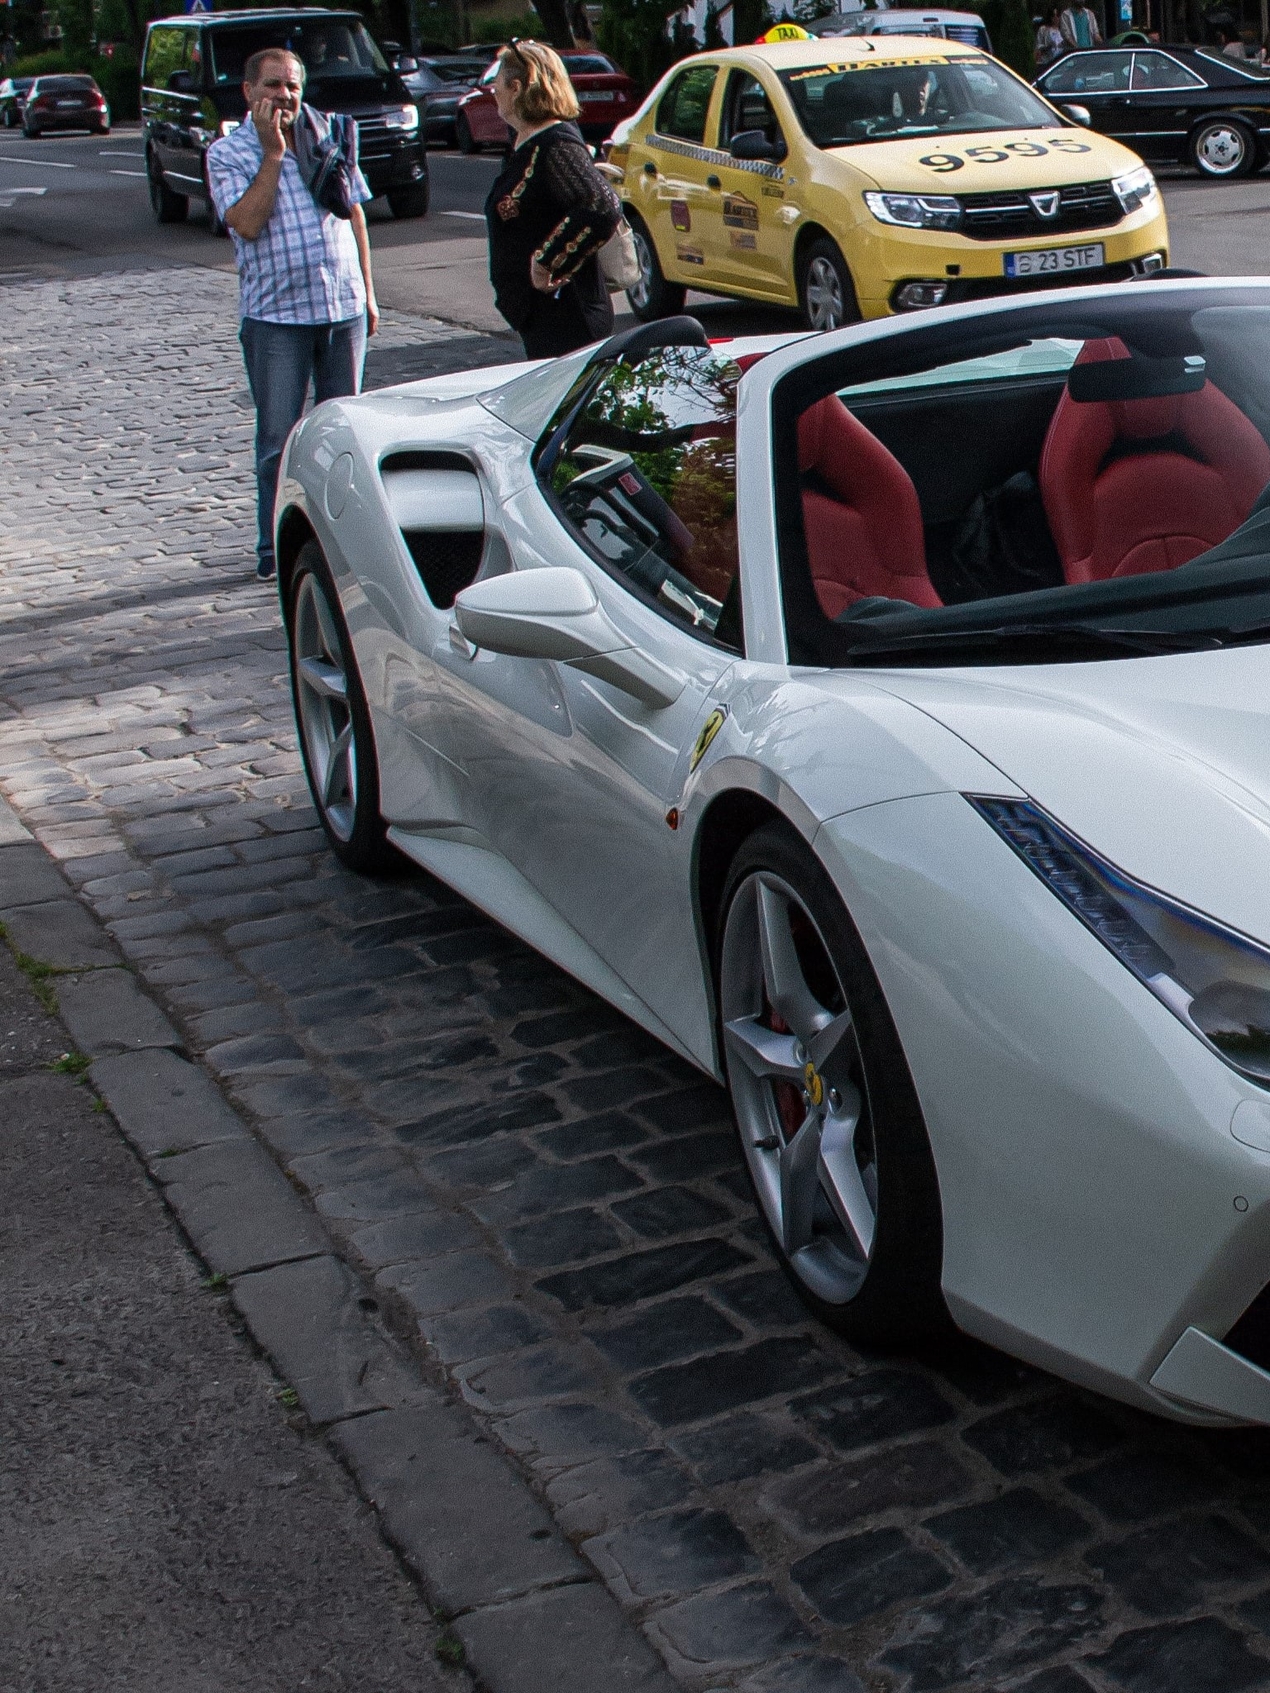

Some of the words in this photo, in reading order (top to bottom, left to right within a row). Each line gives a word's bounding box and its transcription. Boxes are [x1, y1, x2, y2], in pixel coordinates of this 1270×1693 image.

[776, 27, 800, 40] TAXI
[918, 138, 1092, 172] 9595
[1038, 252, 1058, 271] 23
[1063, 247, 1096, 268] STF
